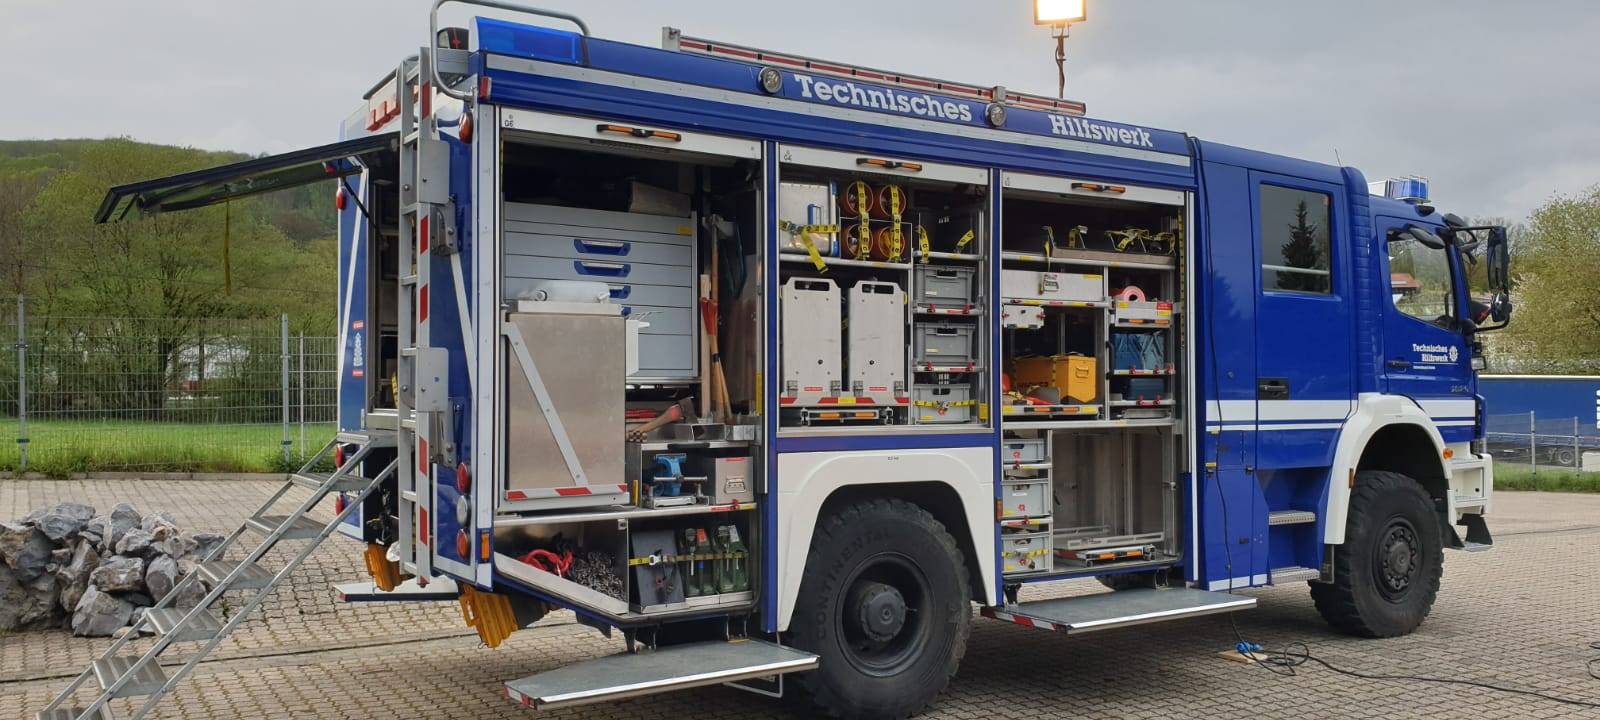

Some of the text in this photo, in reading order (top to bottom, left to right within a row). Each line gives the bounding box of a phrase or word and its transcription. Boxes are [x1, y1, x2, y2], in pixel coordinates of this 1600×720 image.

[794, 73, 1154, 148] Technisches Hilfswerk
[1412, 343, 1448, 352] Technisches
[815, 528, 890, 638] CONTINENTAL
